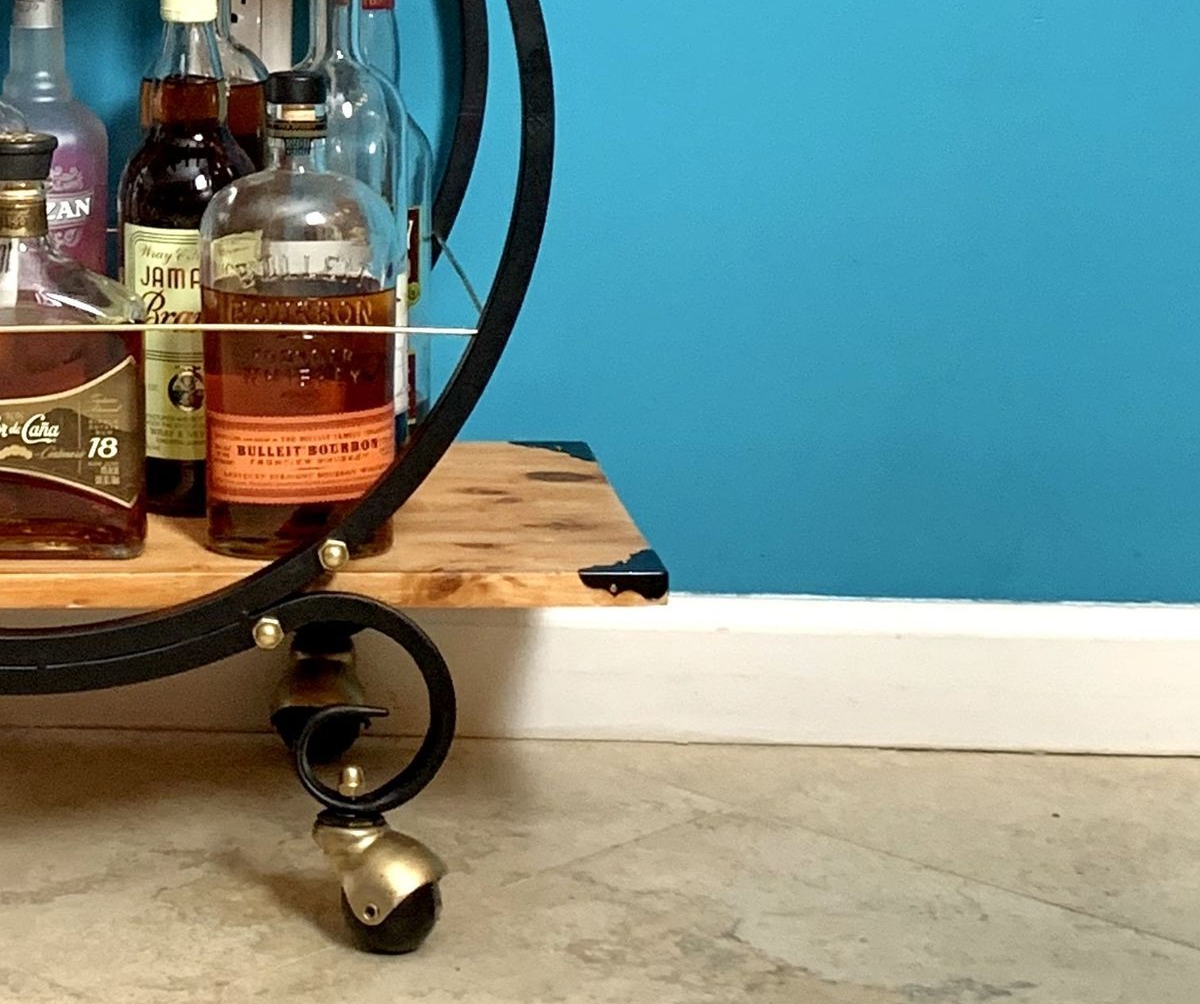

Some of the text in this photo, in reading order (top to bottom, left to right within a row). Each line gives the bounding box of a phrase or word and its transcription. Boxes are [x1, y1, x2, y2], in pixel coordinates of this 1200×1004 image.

[21, 413, 60, 445] Caña
[87, 437, 119, 459] 18
[237, 445, 302, 458] BULLEIT
[307, 437, 379, 457] BOURBON
